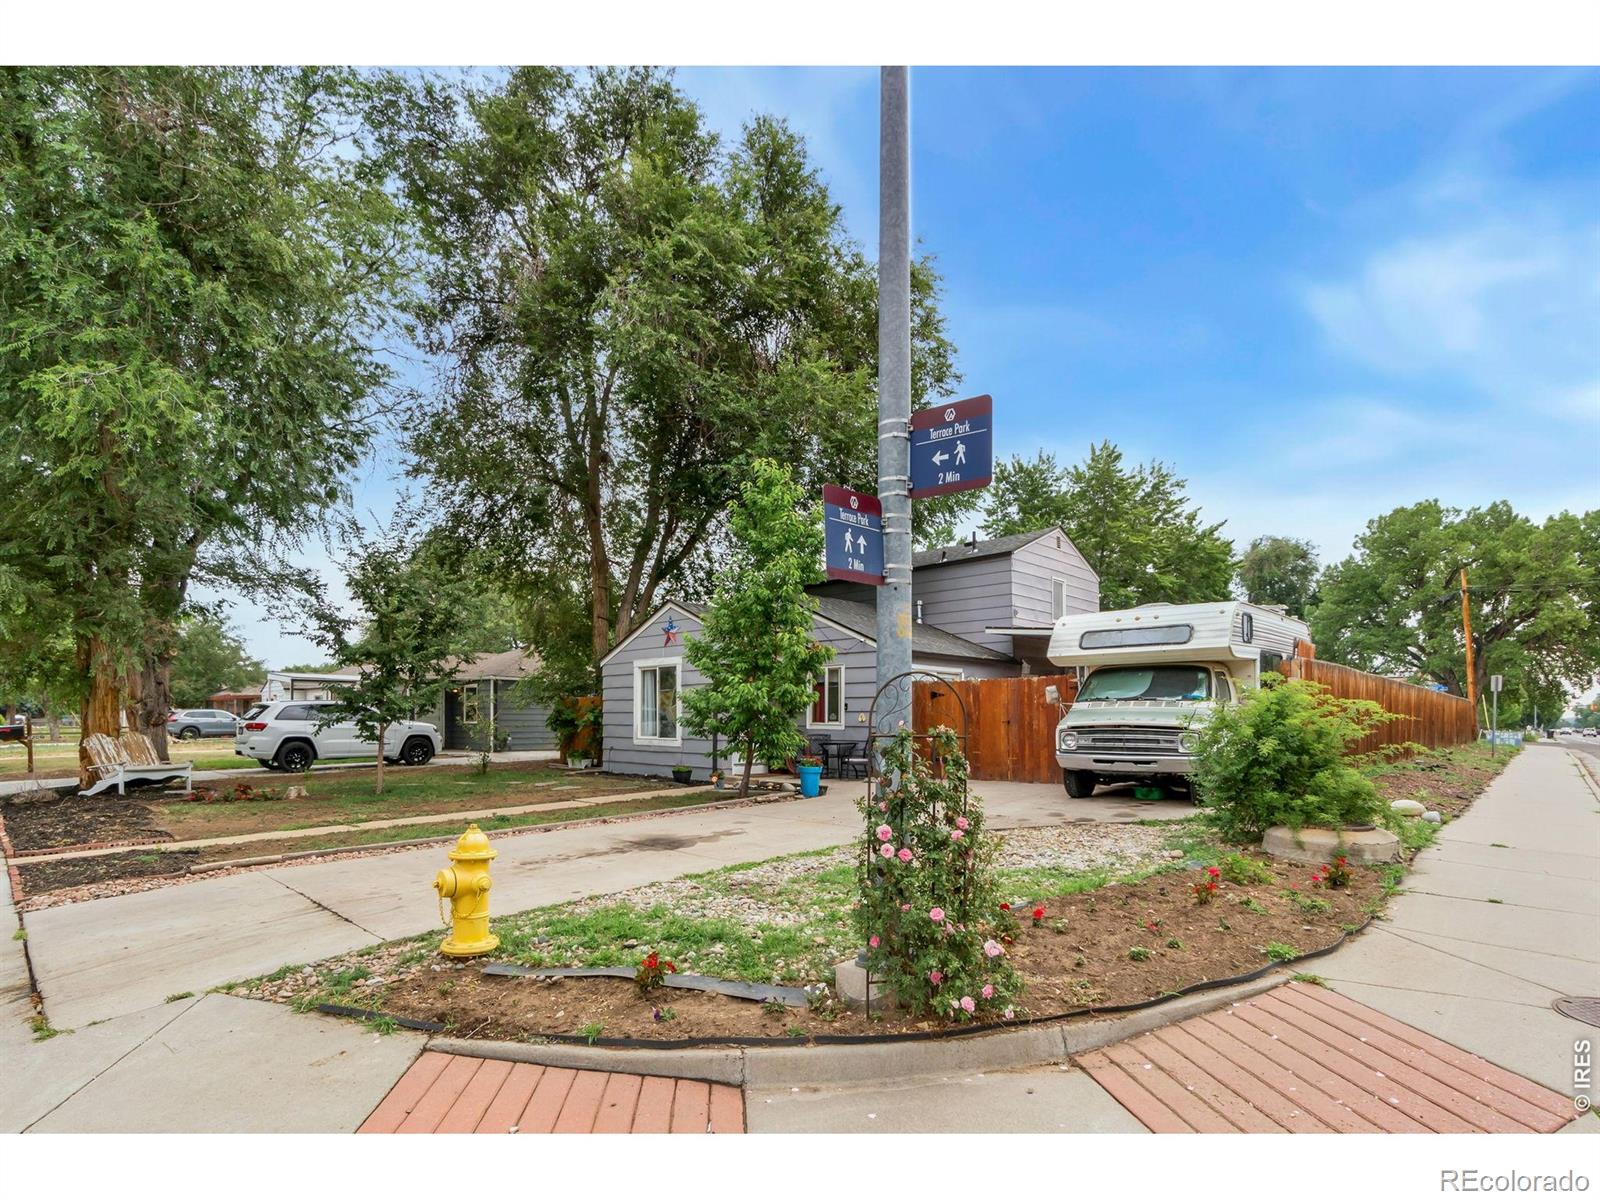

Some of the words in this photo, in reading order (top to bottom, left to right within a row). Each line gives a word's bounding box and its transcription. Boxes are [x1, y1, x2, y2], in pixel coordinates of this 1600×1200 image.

[929, 428, 952, 440] Terrace
[954, 420, 971, 434] Park
[938, 472, 943, 485] 2
[945, 470, 960, 484] Min
[839, 507, 857, 524] Terrace
[857, 512, 870, 526] Park
[848, 557, 853, 570] 2
[853, 558, 865, 572] Min
